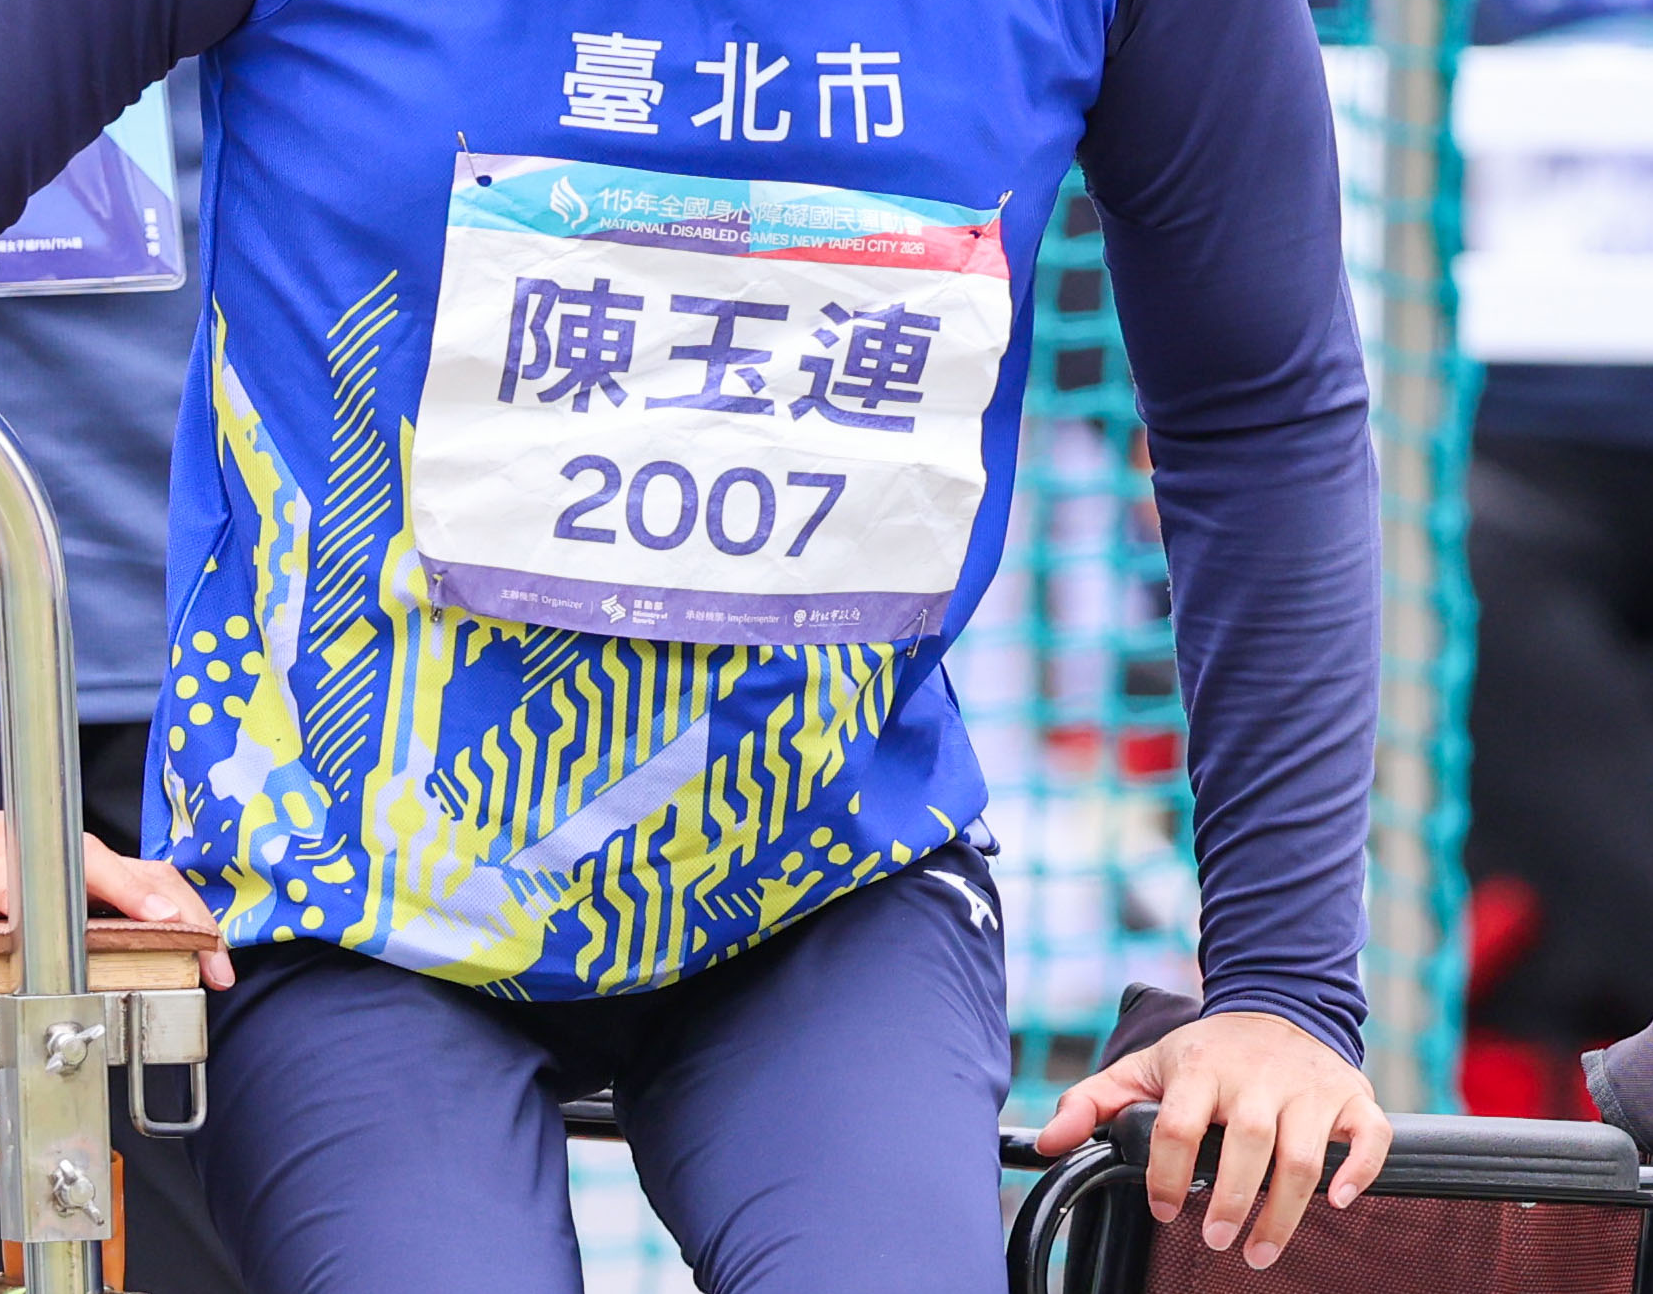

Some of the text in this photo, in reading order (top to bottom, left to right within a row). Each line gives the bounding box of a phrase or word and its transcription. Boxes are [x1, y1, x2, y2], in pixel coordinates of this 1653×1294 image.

[558, 31, 905, 144] 臺北市
[599, 216, 926, 255] NATIONAL DISABLED GAMES NEW TAIPEI CITY 2026
[497, 275, 942, 434] 陳玉連
[552, 453, 847, 558] 2007
[541, 595, 585, 610] Organizer
[727, 612, 781, 626] Implementer
